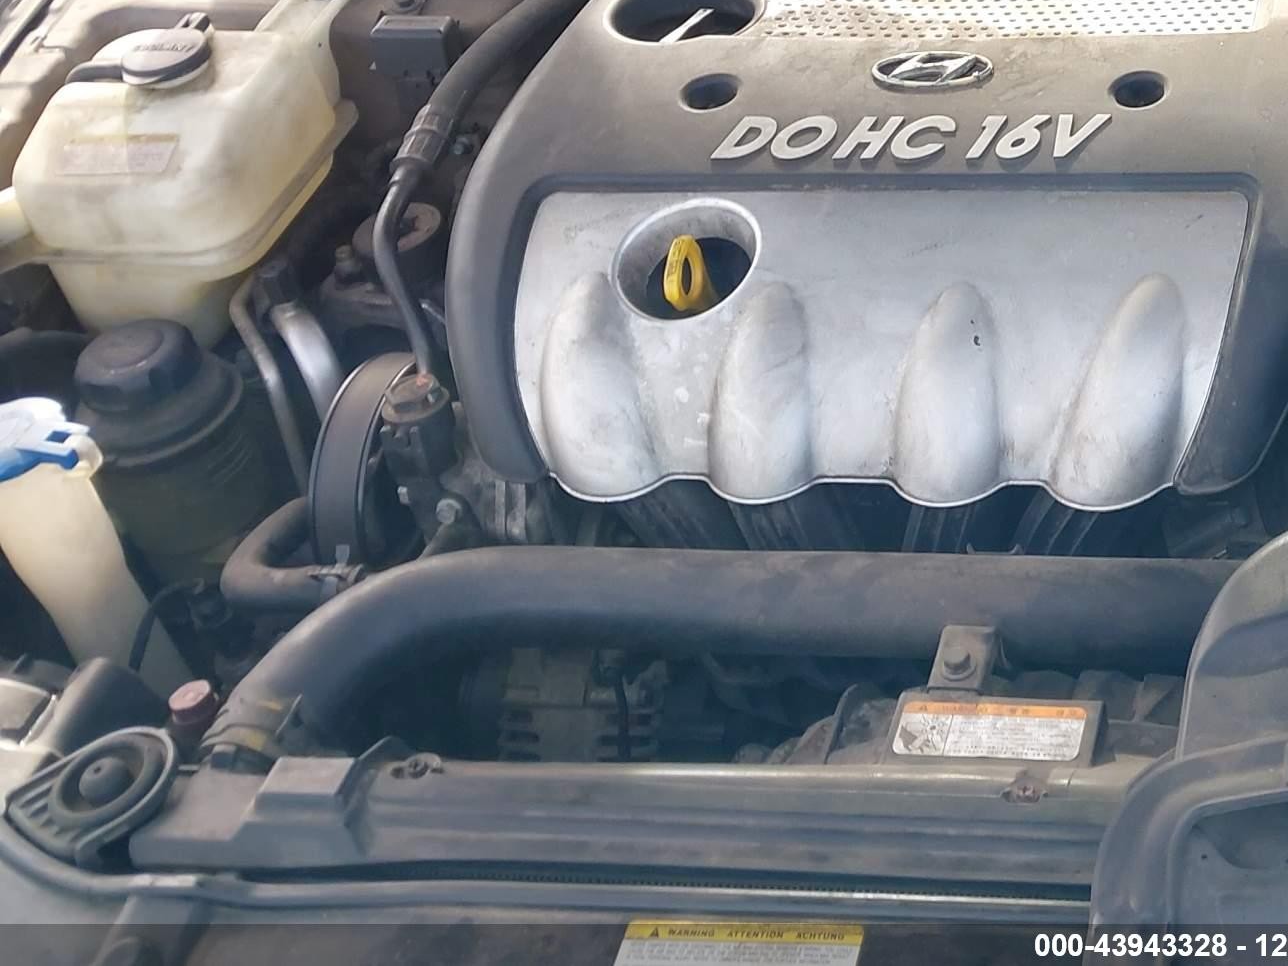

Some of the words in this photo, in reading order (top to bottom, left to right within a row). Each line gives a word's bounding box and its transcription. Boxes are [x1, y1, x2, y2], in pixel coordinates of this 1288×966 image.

[710, 115, 956, 160] DOHC
[966, 113, 1112, 160] 16V
[668, 929, 715, 938] WARNING
[727, 930, 784, 939] ATTENTION
[796, 931, 844, 940] ACHTUNG
